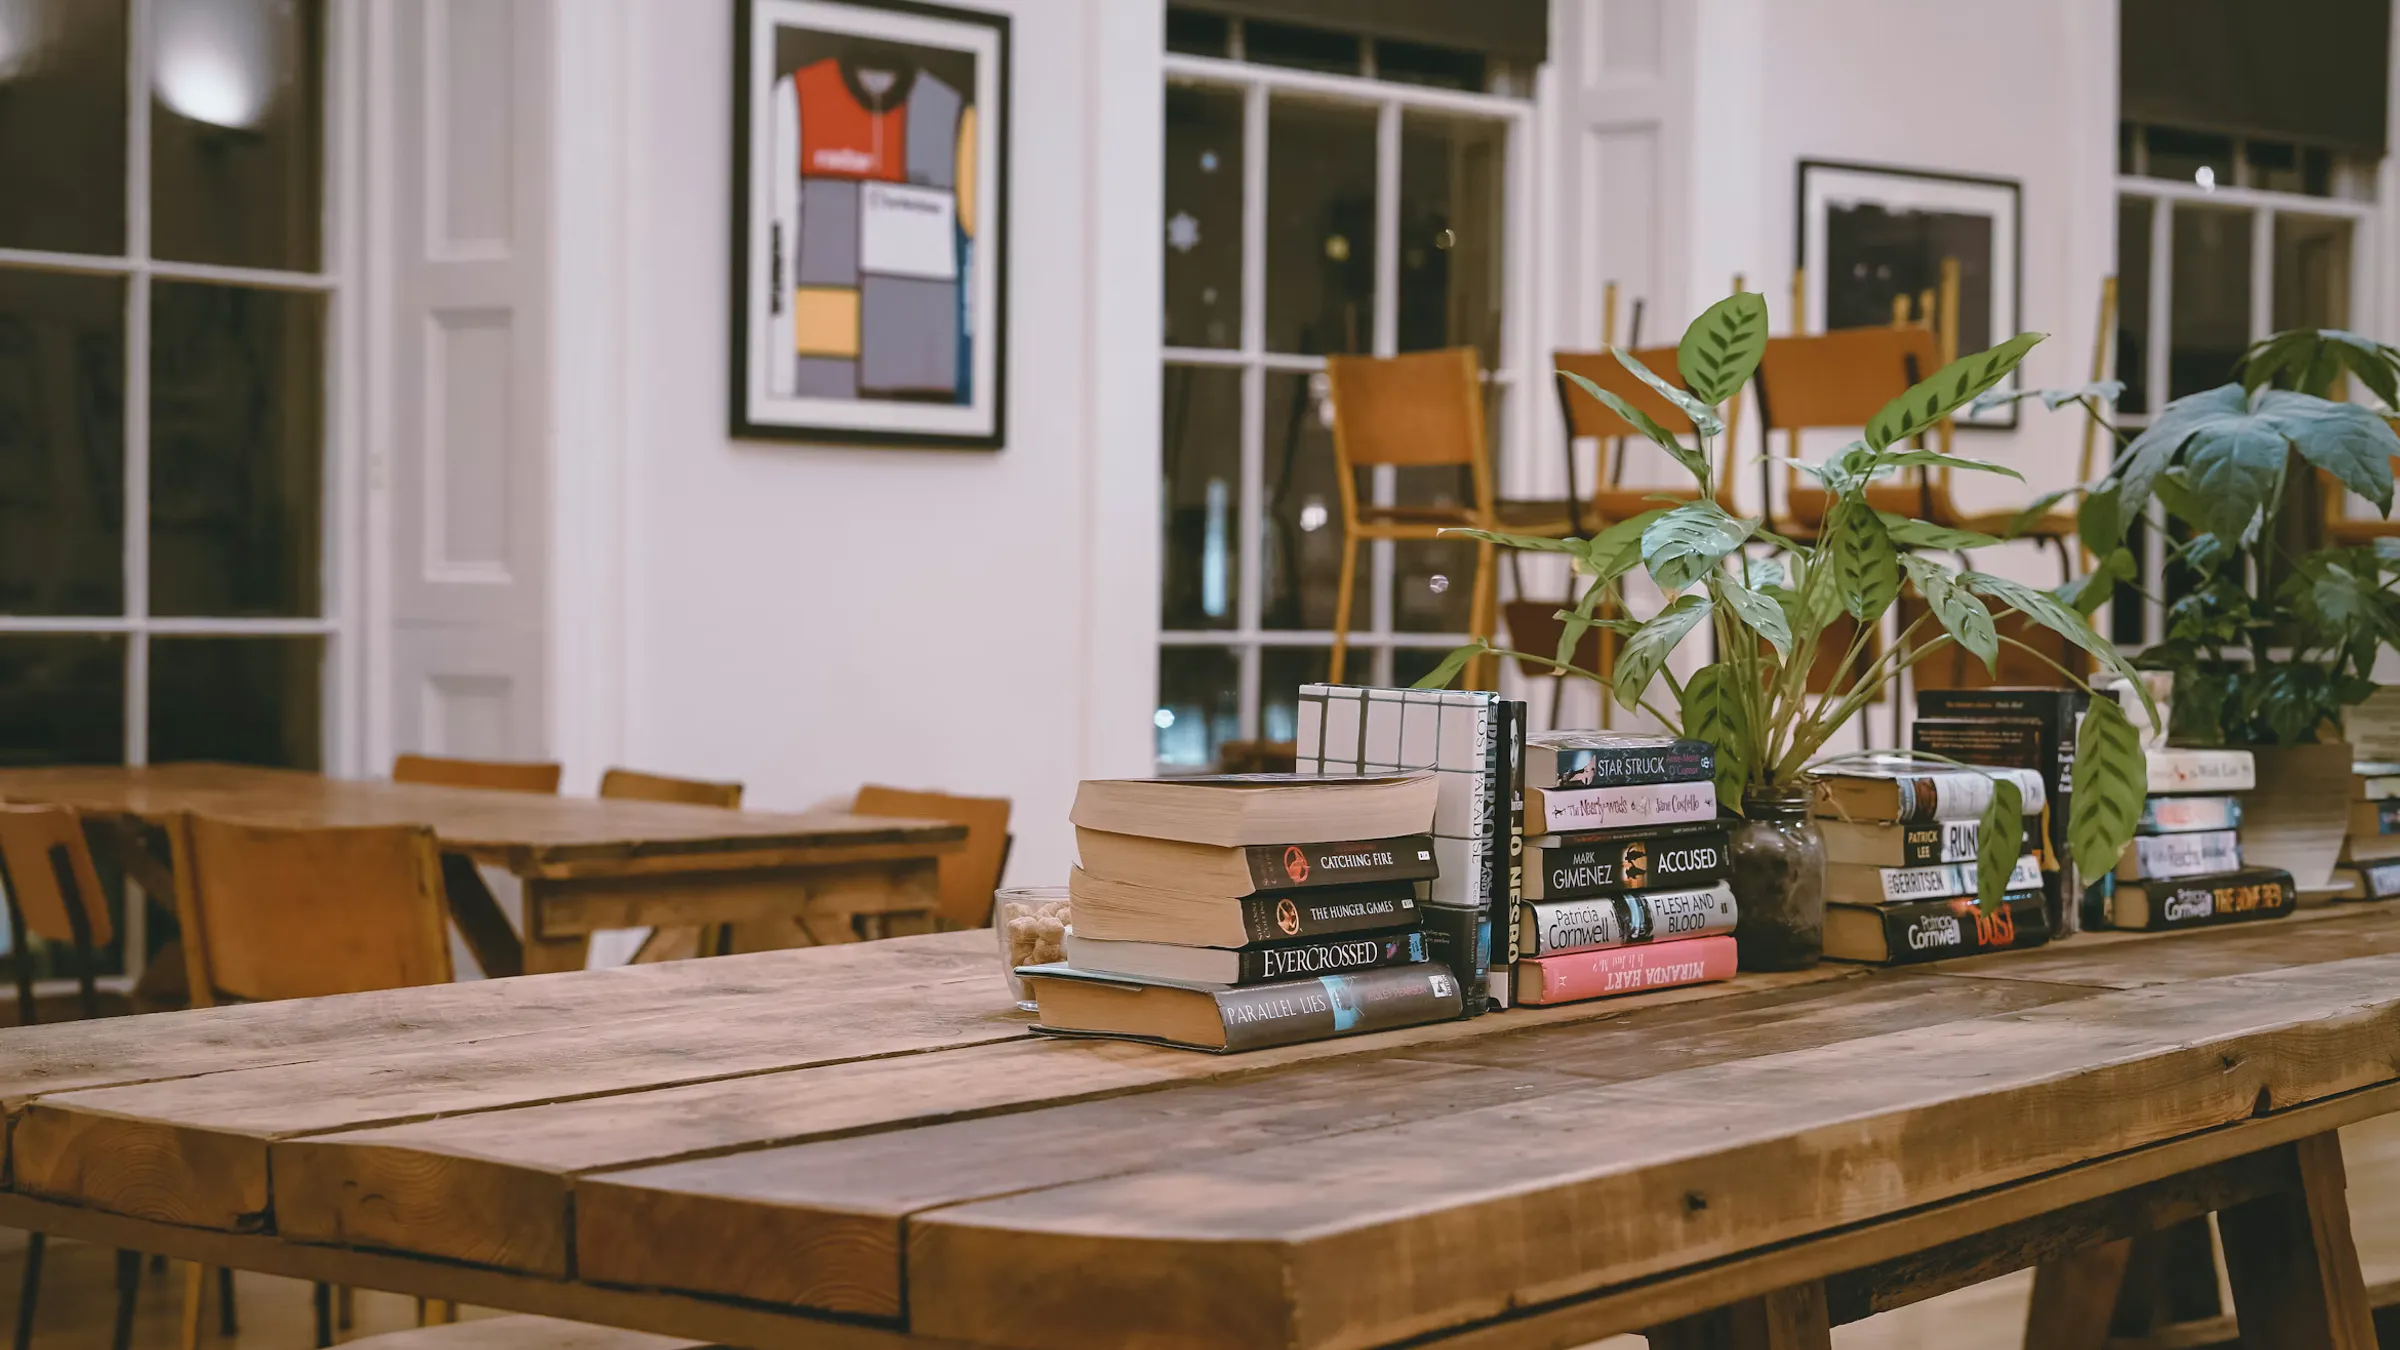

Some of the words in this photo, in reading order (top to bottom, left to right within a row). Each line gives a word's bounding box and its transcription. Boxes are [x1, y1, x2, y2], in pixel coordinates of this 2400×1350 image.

[1475, 709, 1487, 757] LOST
[1598, 759, 1623, 777] STAR
[1625, 757, 1665, 775] STRUCK
[1656, 798, 1671, 814] Jane
[1510, 816, 1523, 857] JO
[1908, 830, 1938, 844] PATRICK
[1320, 853, 1371, 869] CATCHING
[1372, 852, 1394, 866] FIRE
[1573, 852, 1595, 865] MARK
[1657, 848, 1717, 873] ACCUSED
[1917, 846, 1930, 859] LEE
[1552, 864, 1613, 889] GIMENEZ
[1892, 871, 1944, 894] GERRITSEN
[1310, 907, 1329, 921] THE
[1330, 904, 1366, 919] HUNGER
[1366, 901, 1394, 914] GAMES
[1655, 897, 1689, 916] FLESH
[1693, 894, 1715, 911] AND
[1555, 906, 1599, 927] Patricia
[1668, 913, 1706, 933] BLOOD
[1549, 917, 1610, 949] Cornwell
[1908, 919, 1961, 950] Cornwell
[1262, 941, 1378, 978] EVERCROSSED
[1604, 969, 1641, 991] HART
[1646, 961, 1705, 985] MIRANDA
[1227, 999, 1296, 1025] PARALLEL
[1300, 994, 1327, 1014] LIES
